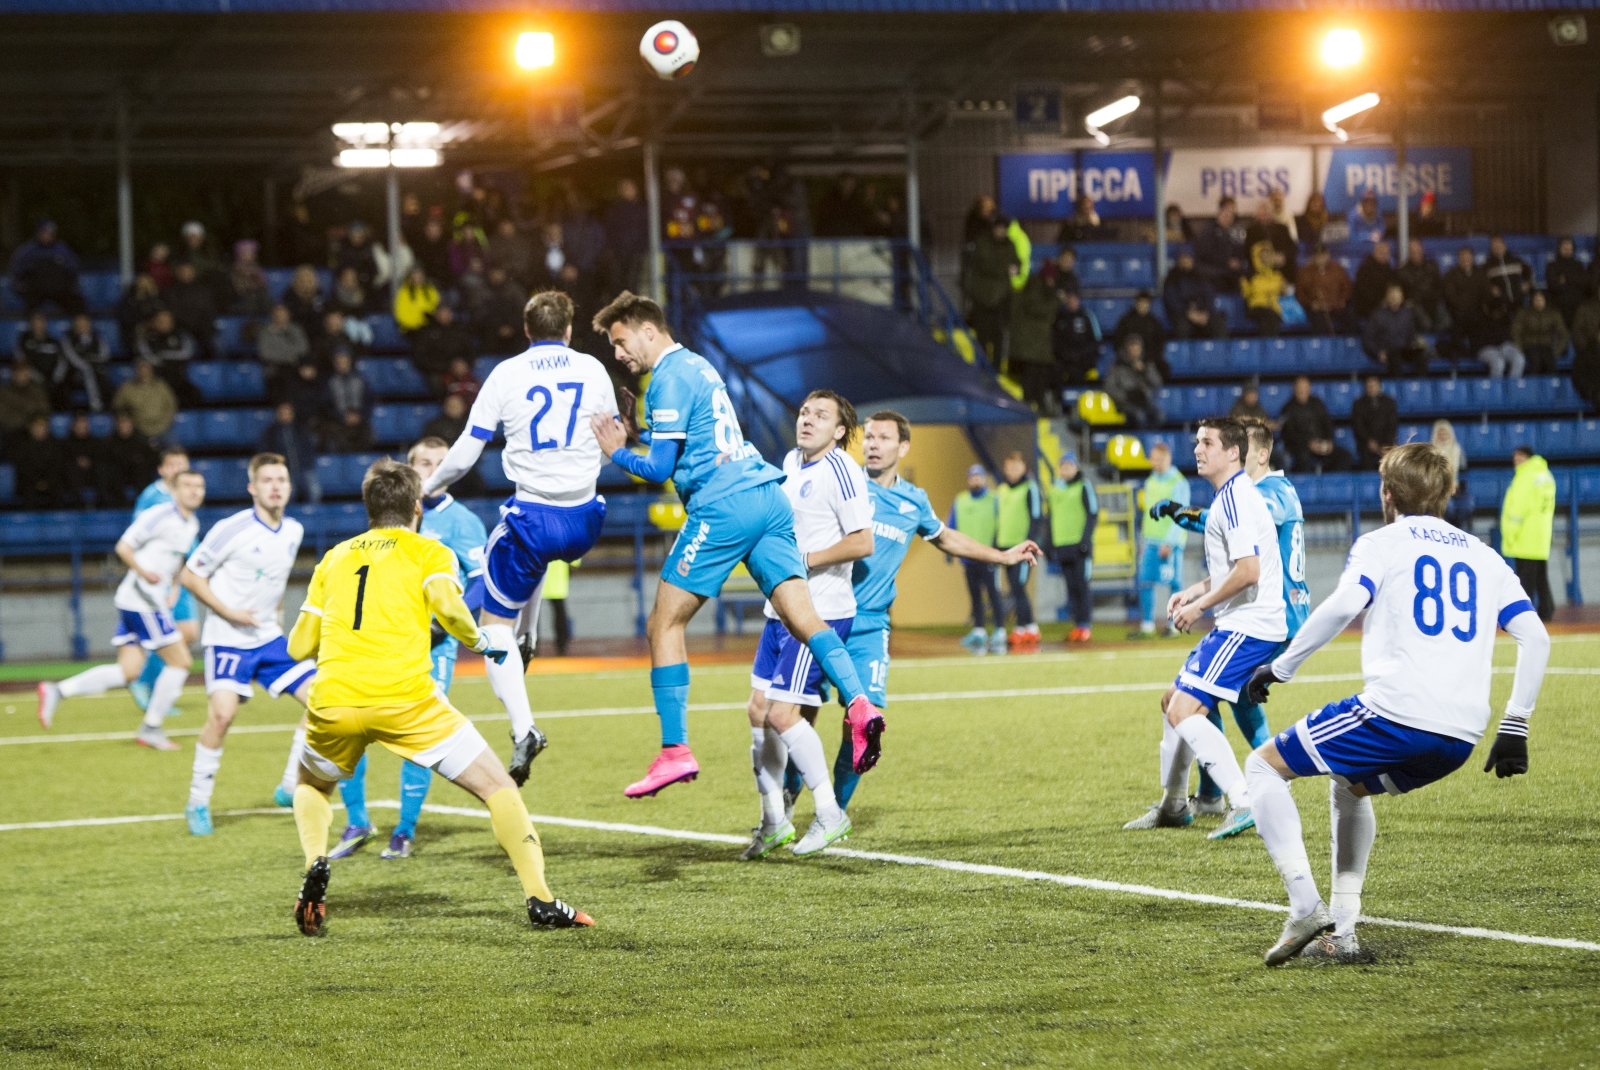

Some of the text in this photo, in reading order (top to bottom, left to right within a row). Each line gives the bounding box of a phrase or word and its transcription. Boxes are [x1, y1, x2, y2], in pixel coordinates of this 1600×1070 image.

[1201, 166, 1290, 197] PRESS
[1346, 162, 1452, 196] PRESSE
[526, 381, 584, 451] 27
[350, 538, 398, 551] САУТИН
[1409, 526, 1469, 549] КАСЬЯН
[352, 564, 370, 631] 1
[1413, 554, 1477, 643] 89
[216, 651, 241, 676] 77
